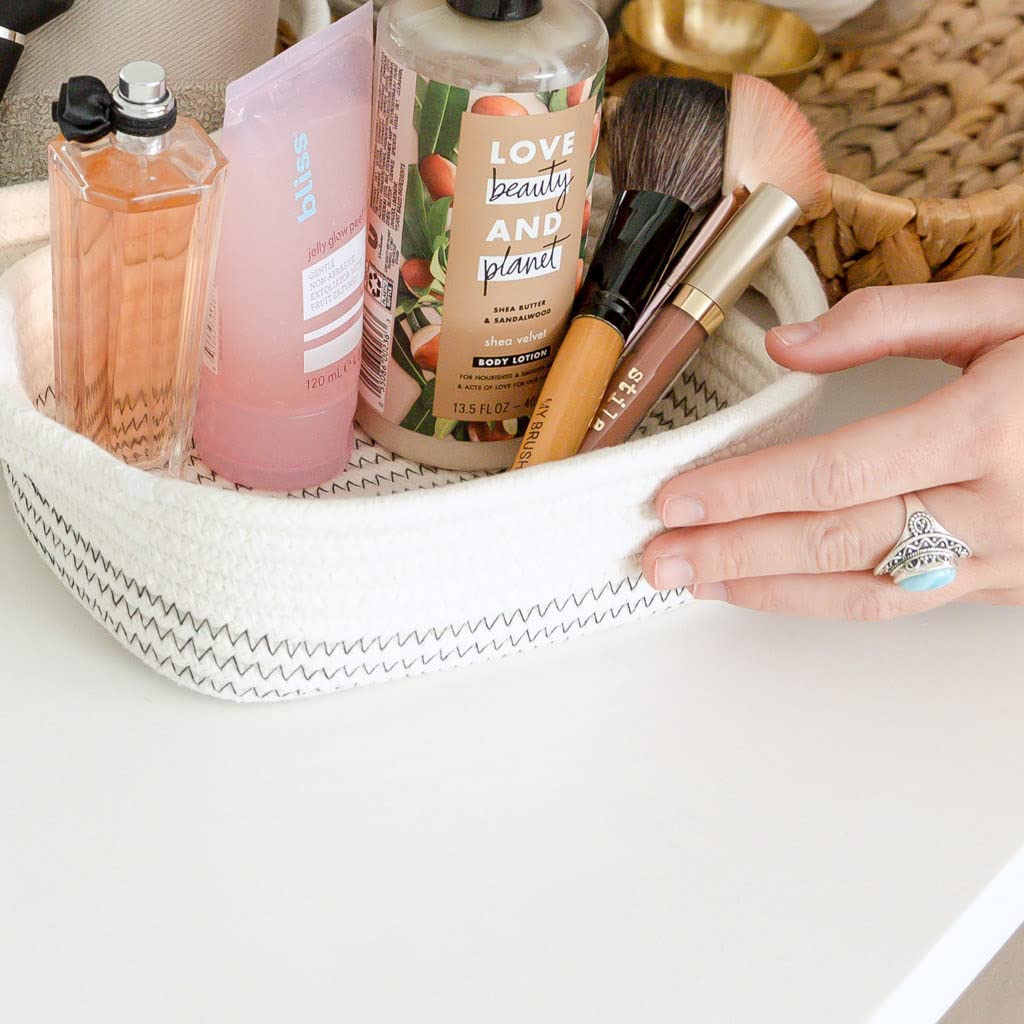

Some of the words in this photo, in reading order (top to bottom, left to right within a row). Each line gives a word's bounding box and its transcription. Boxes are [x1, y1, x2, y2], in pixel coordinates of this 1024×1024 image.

[489, 130, 576, 165] LOVE
[293, 132, 317, 224] bliss
[488, 159, 575, 212] beauty
[485, 212, 562, 242] AND
[307, 240, 327, 263] jelly
[328, 231, 349, 249] glow
[483, 234, 572, 297] planet
[493, 306, 516, 314] SHEA
[518, 300, 546, 311] BUTTER
[493, 308, 552, 324] SANDALWOOD
[484, 335, 513, 347] shea
[516, 328, 547, 345] velvet
[478, 357, 510, 367] BODY
[512, 349, 548, 365] LOTION
[305, 375, 326, 390] 120
[327, 367, 343, 383] mL
[459, 373, 473, 381] FOR
[474, 373, 513, 382] NOURISHED
[495, 382, 512, 391] LOVE
[513, 380, 525, 388] FOR
[453, 401, 476, 415] 13.5
[479, 403, 492, 415] FL
[494, 401, 510, 414] OZ
[535, 397, 553, 419] MY
[592, 367, 644, 432] stila
